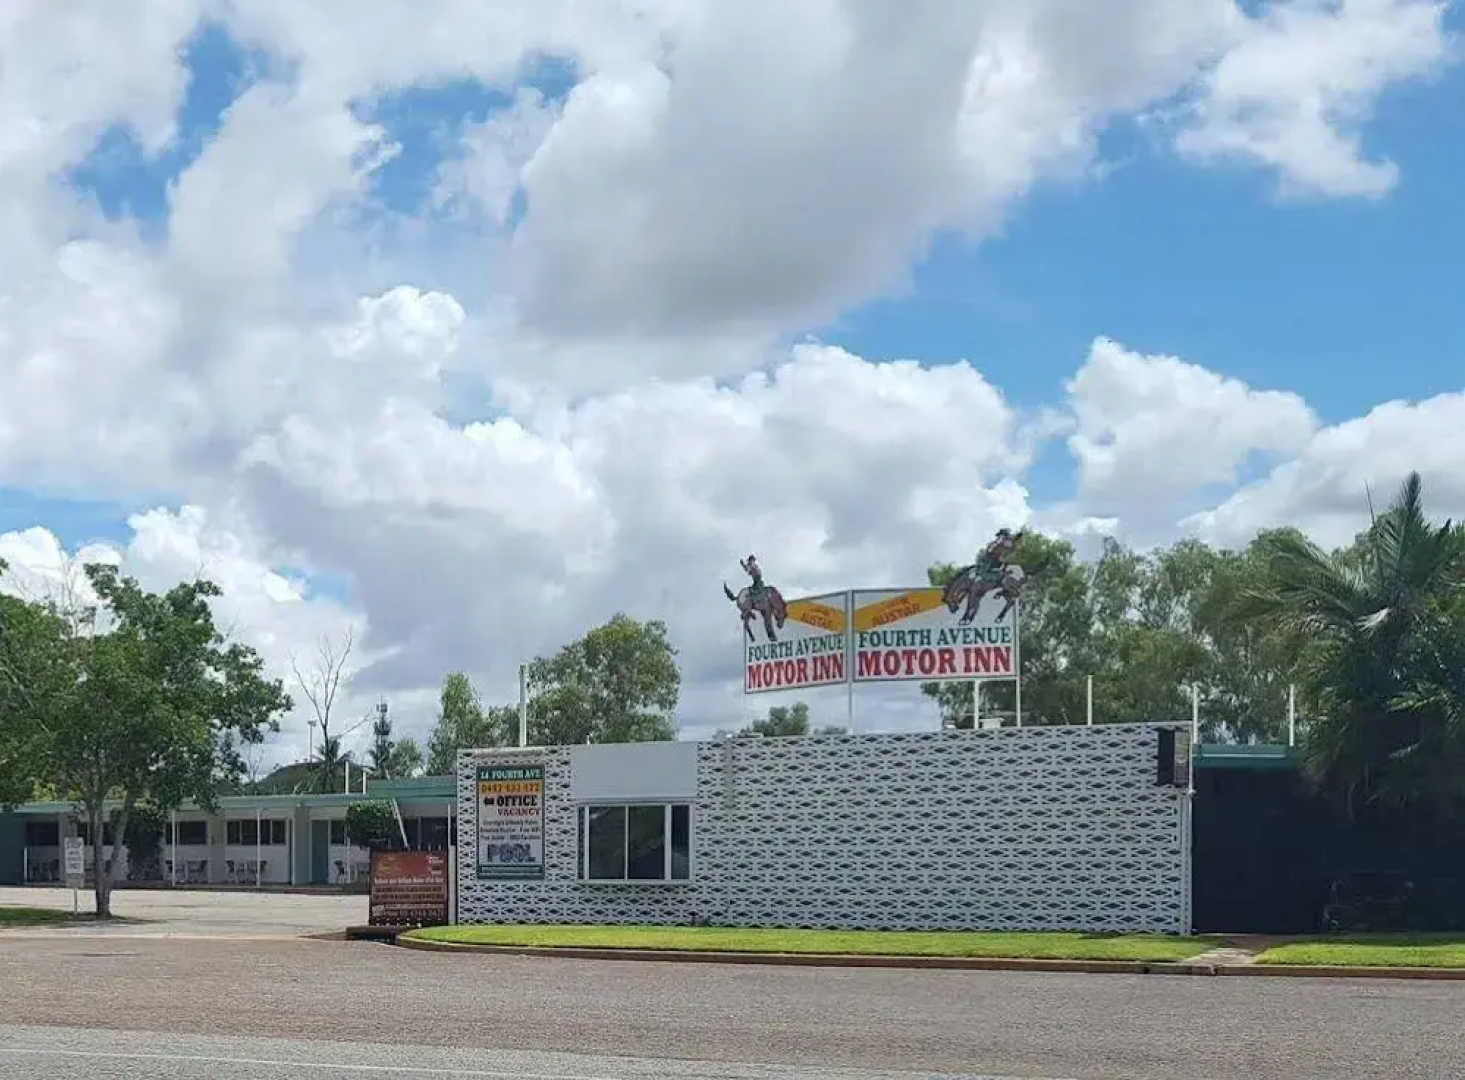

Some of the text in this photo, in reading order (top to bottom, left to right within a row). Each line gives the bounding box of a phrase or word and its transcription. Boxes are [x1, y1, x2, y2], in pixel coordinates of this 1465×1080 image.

[858, 627, 1011, 648] FOURTH AVENUE
[748, 633, 844, 663] FOURTH AVENUE
[748, 652, 844, 689] MOTOR INN
[858, 646, 1011, 676] MOTOR INN
[491, 769, 524, 780] FOURTH
[525, 769, 540, 779] AVE
[497, 795, 538, 807] OFFICE
[498, 808, 540, 817] VACANCY
[487, 843, 537, 863] POOL
